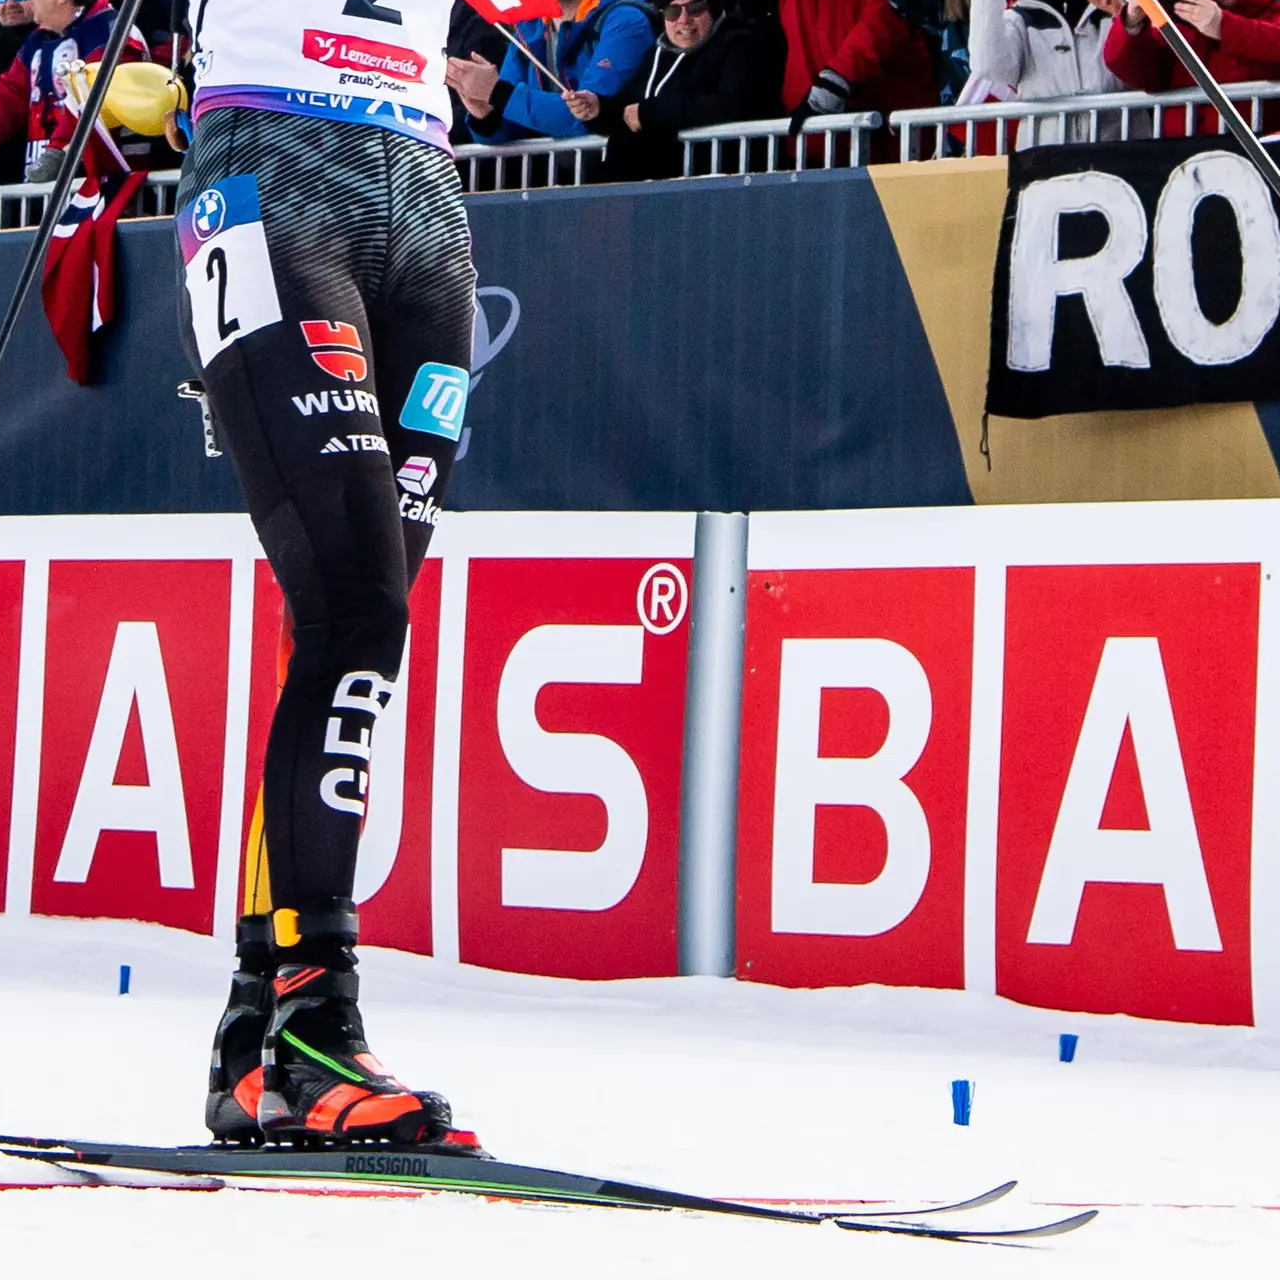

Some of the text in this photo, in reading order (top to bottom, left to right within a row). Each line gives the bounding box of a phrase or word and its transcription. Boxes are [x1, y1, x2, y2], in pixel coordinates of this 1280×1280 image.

[339, 44, 418, 77] Lenzerheide
[206, 246, 241, 342] 2
[291, 389, 380, 417] WÜRT
[422, 373, 463, 430] TQ
[320, 671, 396, 817] GER
[345, 1156, 431, 1176] ROSSIGNOL
